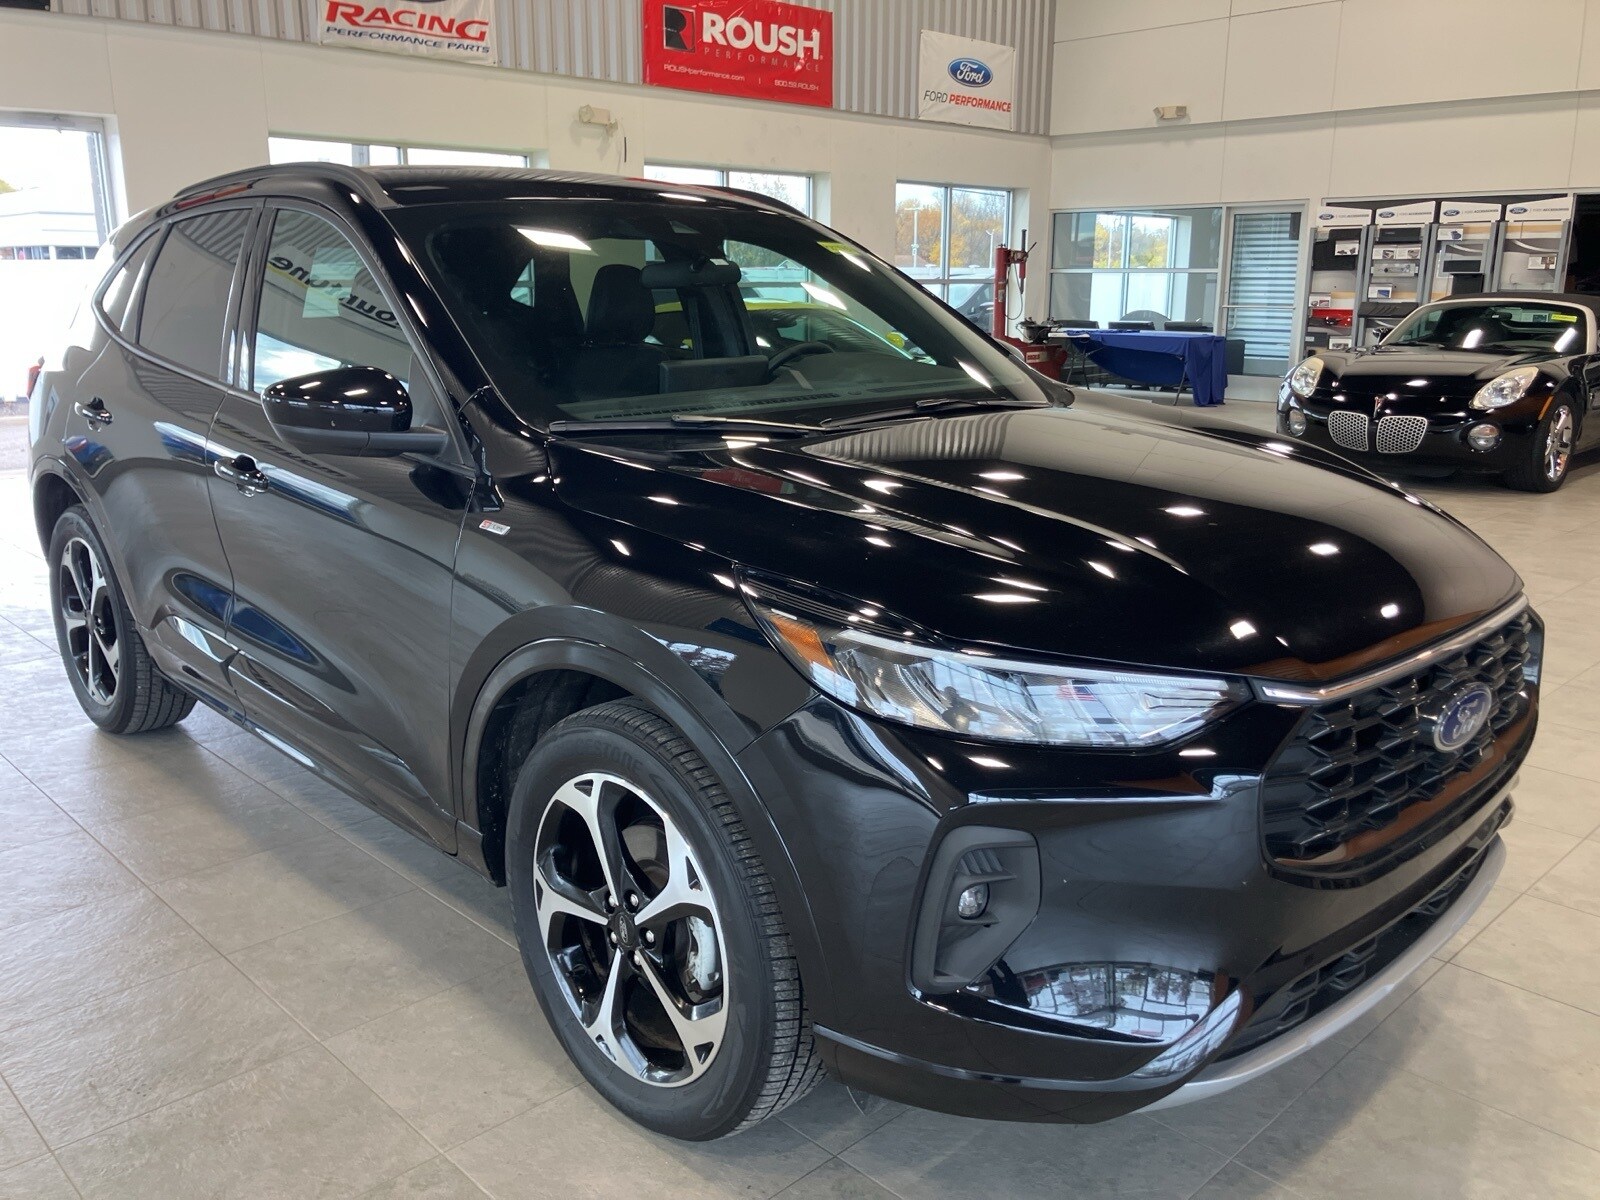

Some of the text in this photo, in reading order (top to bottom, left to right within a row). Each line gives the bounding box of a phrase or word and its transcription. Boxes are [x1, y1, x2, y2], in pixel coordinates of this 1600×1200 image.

[326, 1, 489, 42] RACING
[326, 26, 490, 54] PERFORMANCE PARTS
[702, 11, 820, 60] ROUSH
[704, 47, 820, 72] PERFORMANCE
[956, 61, 985, 84] Ford
[923, 90, 1012, 112] FORD PERFORMANCE
